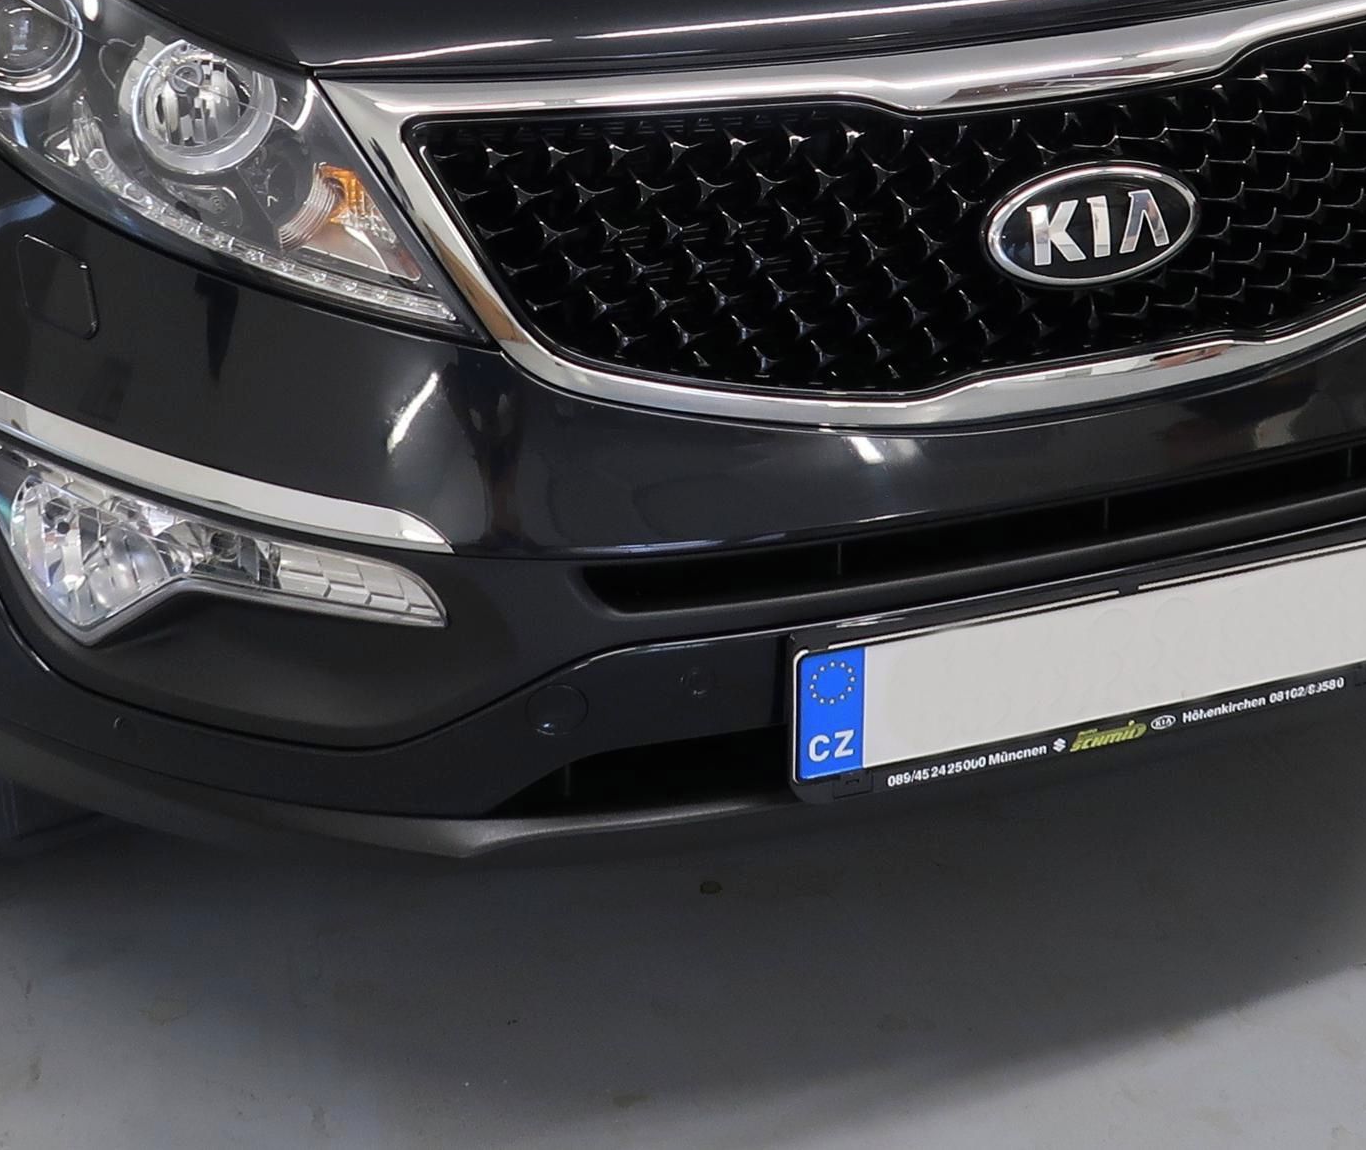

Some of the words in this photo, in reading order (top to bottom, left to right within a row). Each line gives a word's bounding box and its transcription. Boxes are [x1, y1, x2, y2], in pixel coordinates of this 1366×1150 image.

[1026, 189, 1170, 266] KIA
[1182, 696, 1266, 724] Höhenkirchen
[809, 730, 854, 762] CZ
